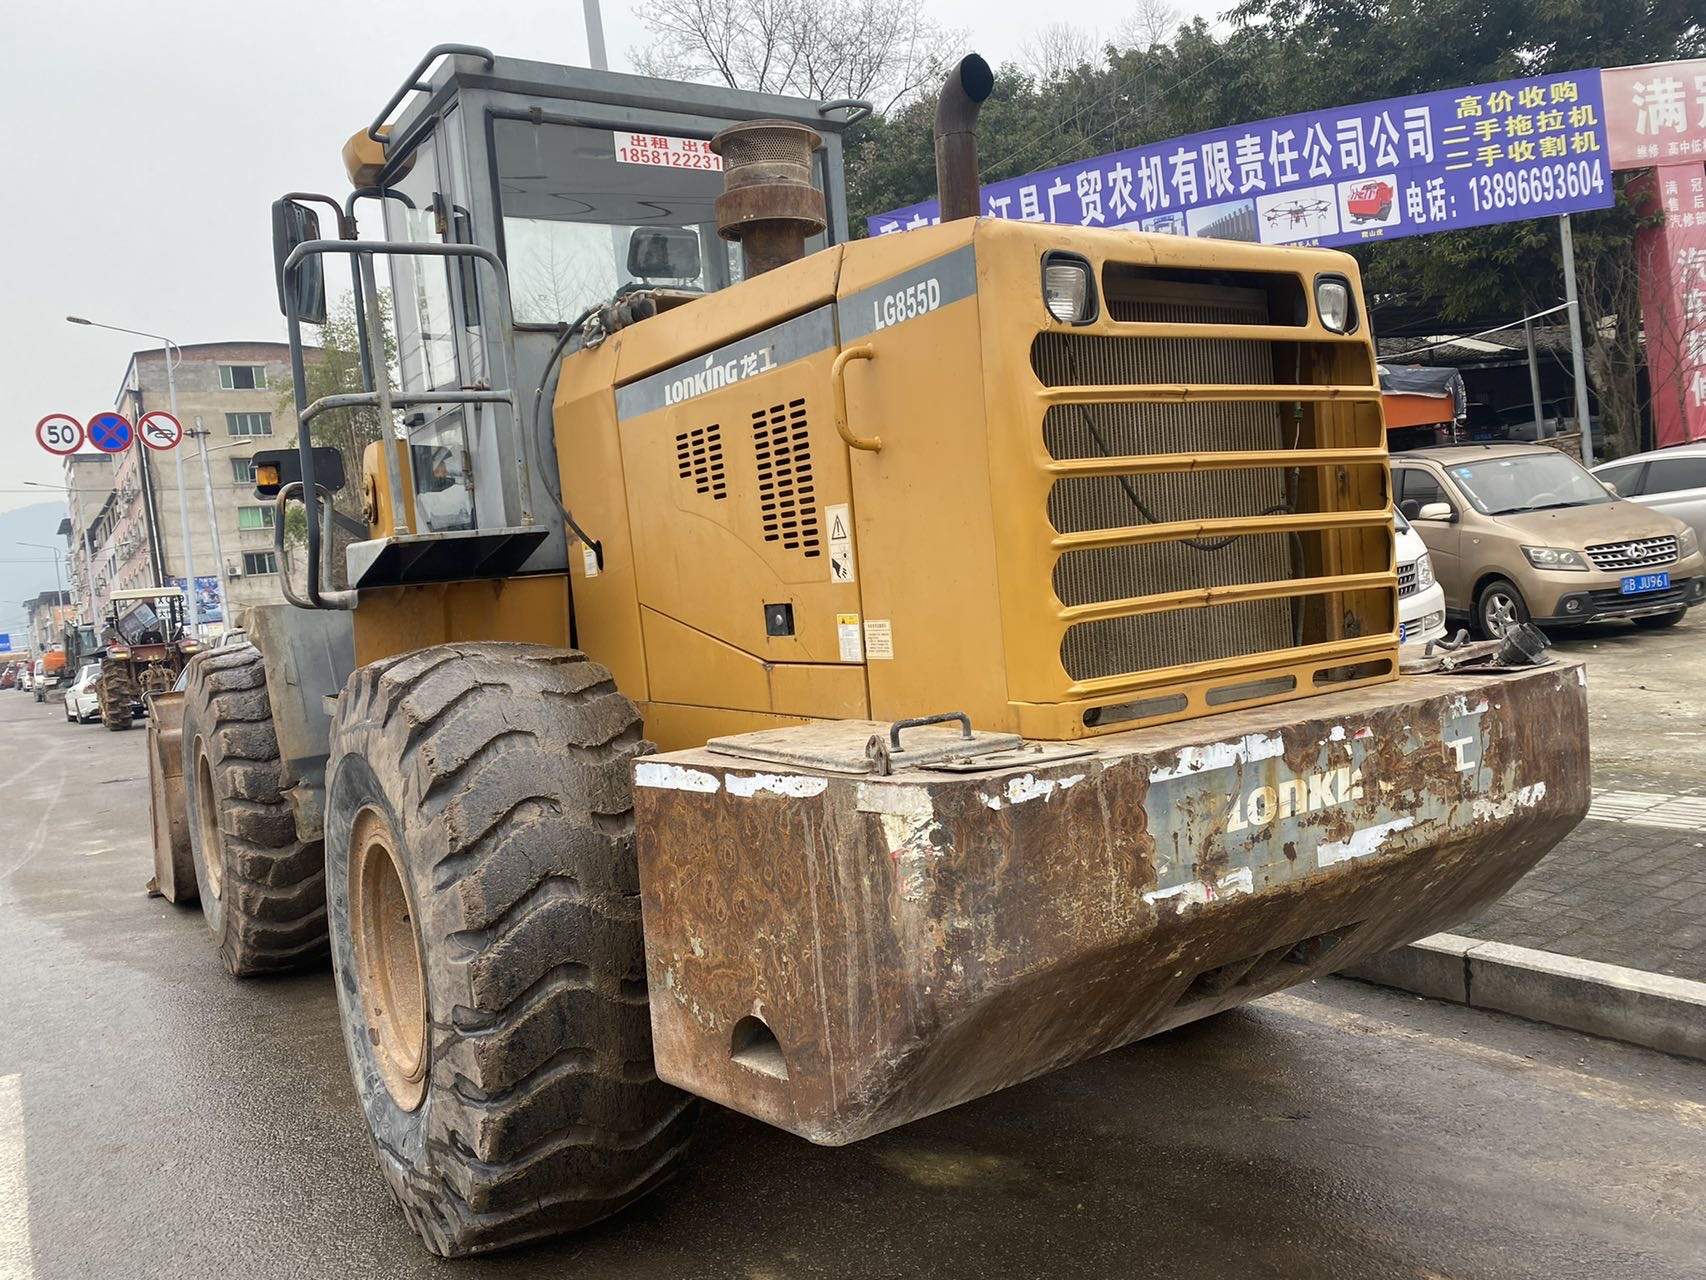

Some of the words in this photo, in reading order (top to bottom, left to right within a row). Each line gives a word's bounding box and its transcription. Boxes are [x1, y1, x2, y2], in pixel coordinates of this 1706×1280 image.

[1455, 81, 1578, 119] 高价收购
[1632, 75, 1706, 135] 满
[631, 135, 669, 150] 出租
[1443, 104, 1598, 144] 二手拖拉机
[1445, 130, 1600, 171] 二手收割机
[1667, 138, 1706, 156] 高中低
[1468, 158, 1605, 212] 13896693604
[873, 278, 941, 331] LG855D
[47, 424, 75, 444] 50
